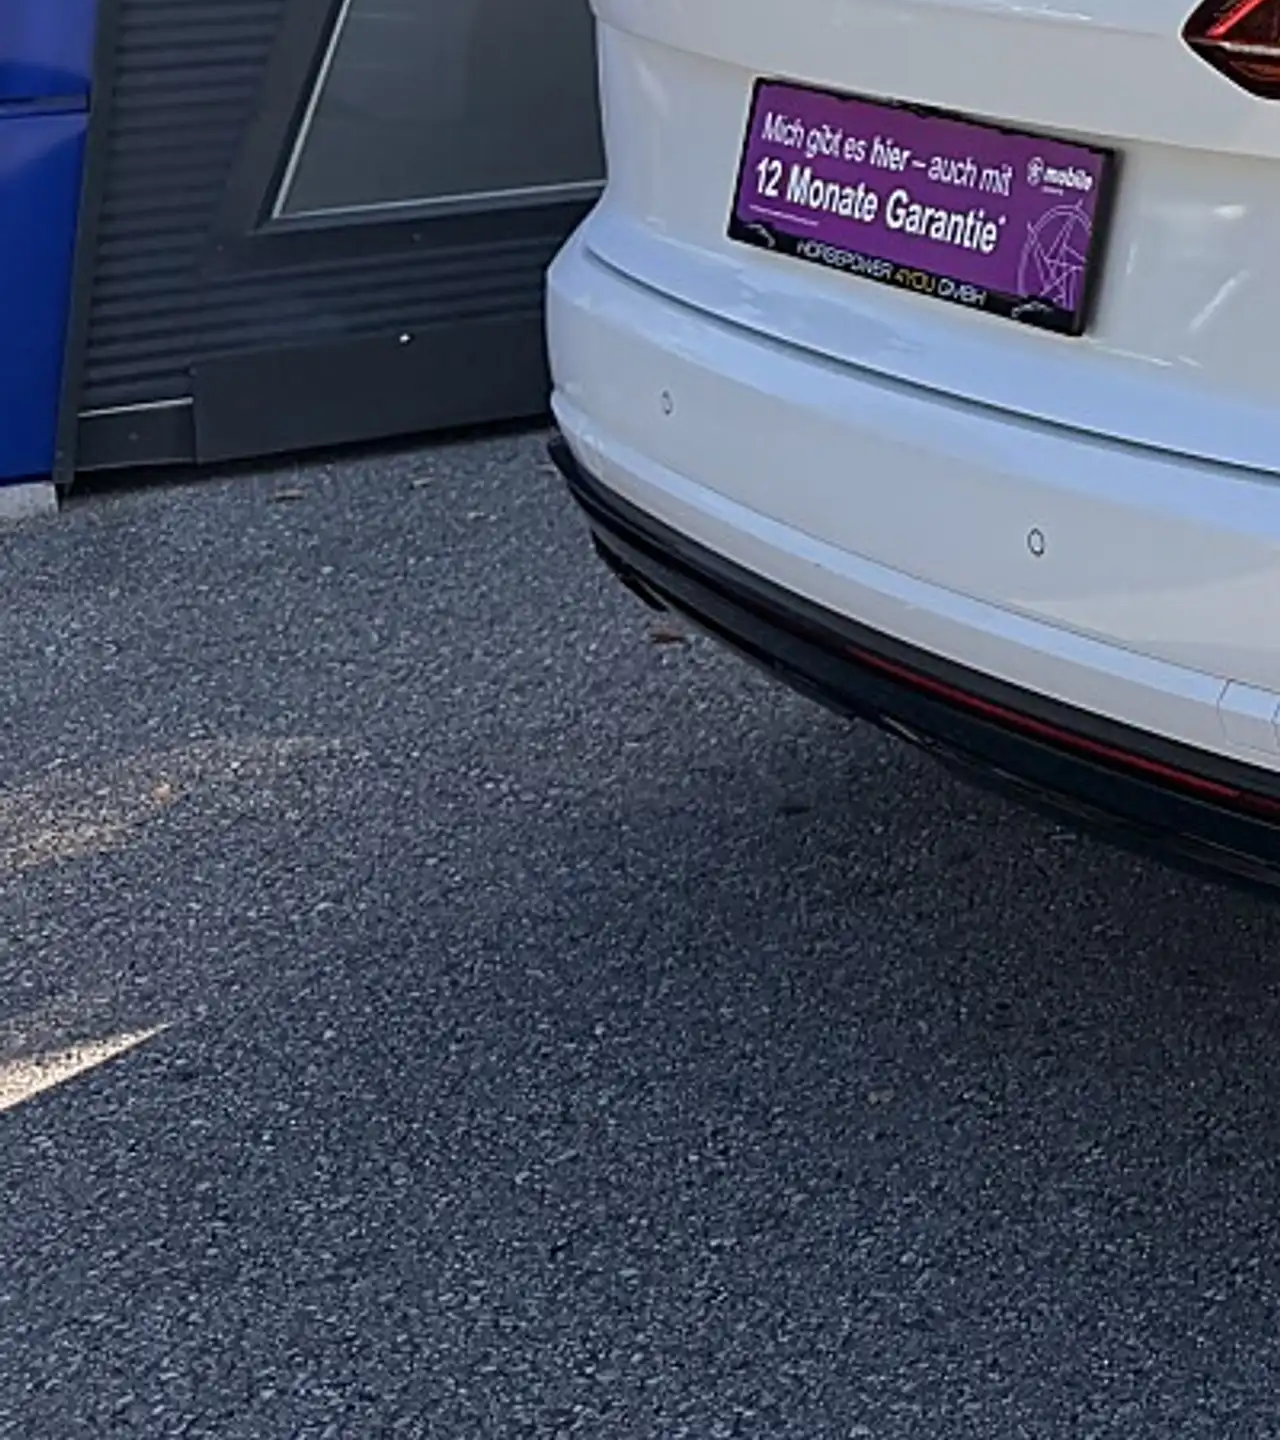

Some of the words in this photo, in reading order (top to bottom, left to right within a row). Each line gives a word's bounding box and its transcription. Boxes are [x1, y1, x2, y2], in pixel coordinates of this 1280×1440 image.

[760, 112, 805, 150] Mich
[806, 124, 842, 160] gibt
[842, 136, 867, 164] es
[869, 134, 911, 173] hier
[928, 155, 978, 190] auch
[978, 164, 1014, 197] mit
[754, 157, 780, 198] 12
[786, 169, 879, 222] Monate
[796, 239, 894, 281] HORSEPOWER
[894, 268, 937, 294] 4YOU
